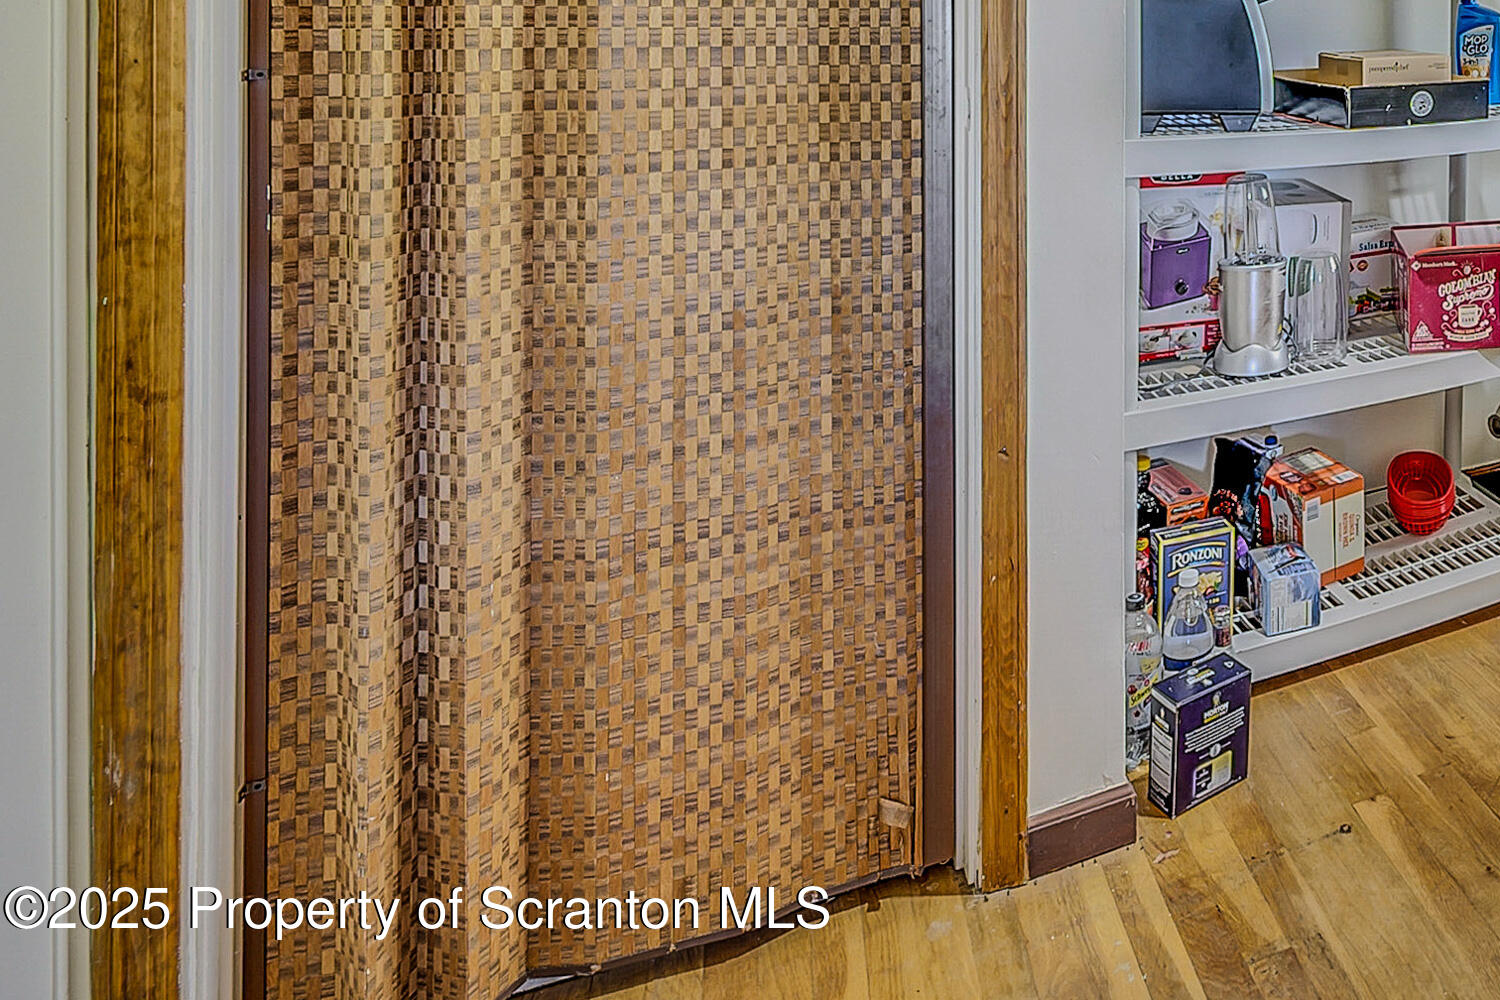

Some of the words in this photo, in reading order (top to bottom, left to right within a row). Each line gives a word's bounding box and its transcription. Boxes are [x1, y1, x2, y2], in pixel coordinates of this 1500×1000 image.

[1463, 35, 1489, 46] MOP
[1359, 242, 1378, 252] Salsa
[1438, 268, 1497, 298] COLOMBIAN
[1442, 283, 1495, 312] Supremo
[1172, 547, 1224, 571] RONZONI
